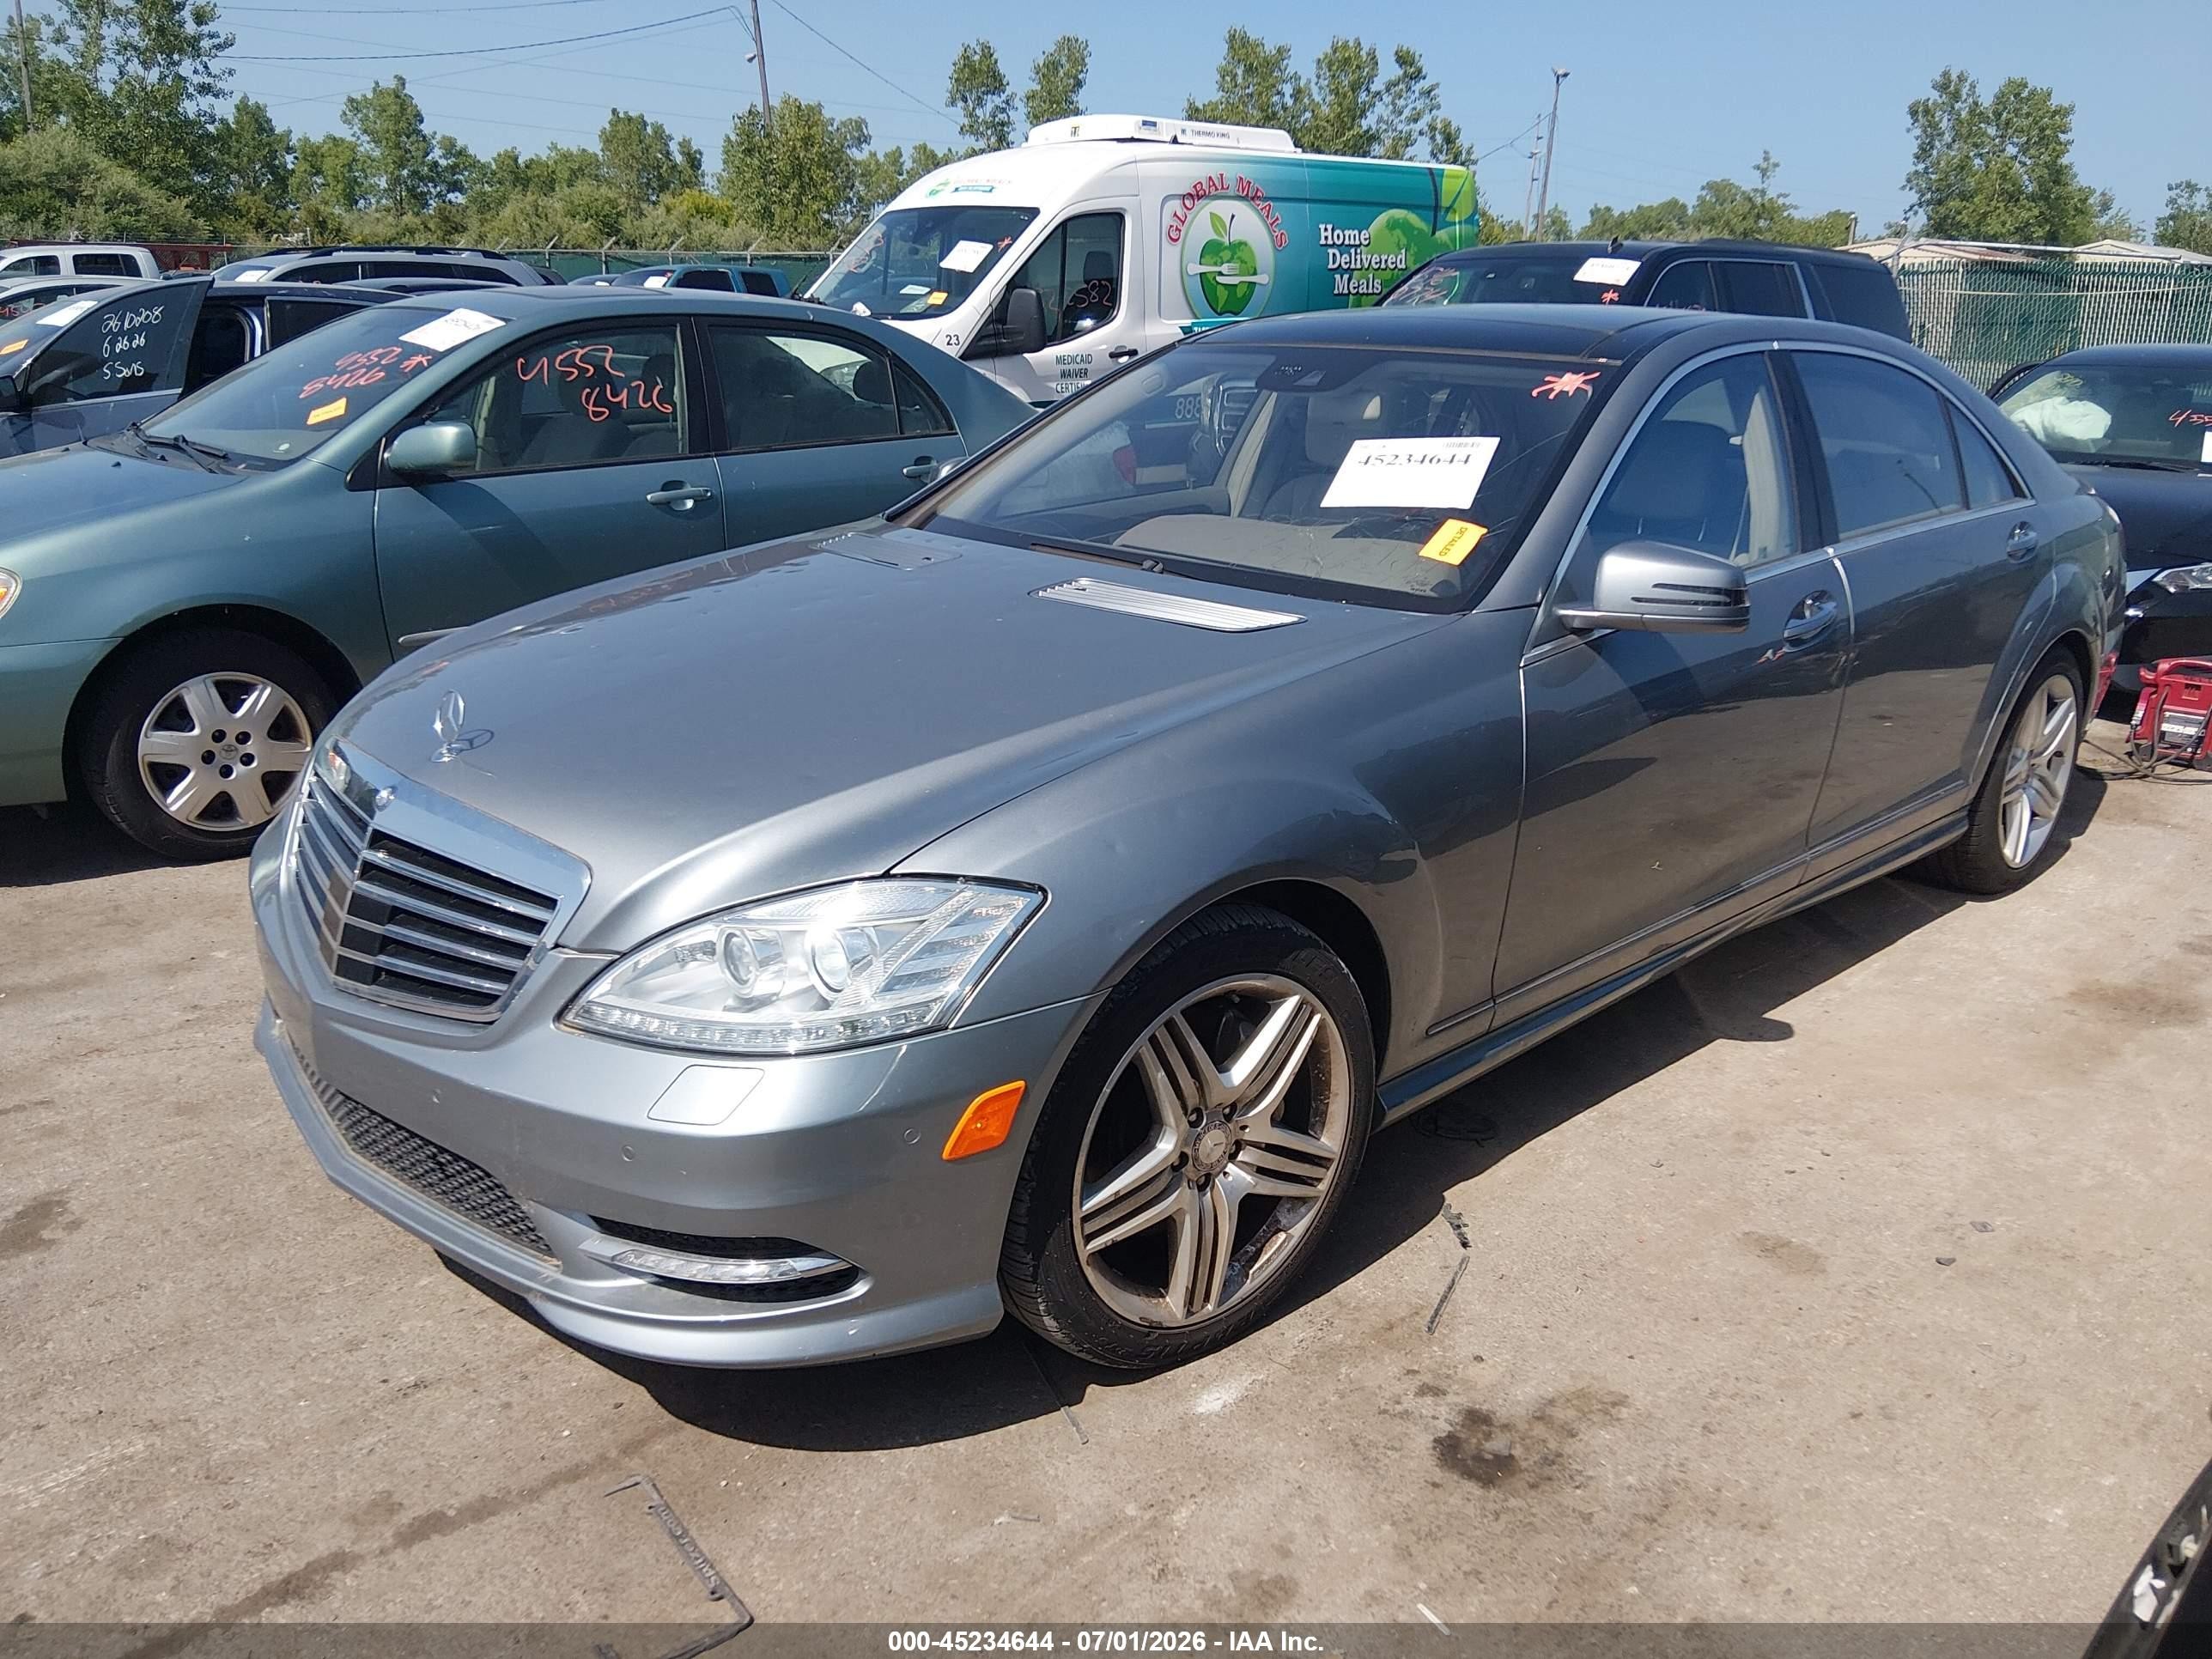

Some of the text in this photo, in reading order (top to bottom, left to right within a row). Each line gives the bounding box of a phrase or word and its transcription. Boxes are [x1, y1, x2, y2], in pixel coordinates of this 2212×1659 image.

[1191, 129, 1231, 139] THERMO KING
[1167, 173, 1288, 250] GLOBAL MEALS
[1319, 223, 1370, 246] Home
[1328, 247, 1407, 269] Delivered
[1334, 273, 1382, 295] Meals
[945, 334, 960, 346] 23
[1055, 353, 1092, 365] MEDICAID
[1060, 368, 1089, 380] WAIVER
[1055, 382, 1085, 394] CERTIF
[1358, 453, 1472, 466] 45234644
[1438, 526, 1468, 556] DETAILED
